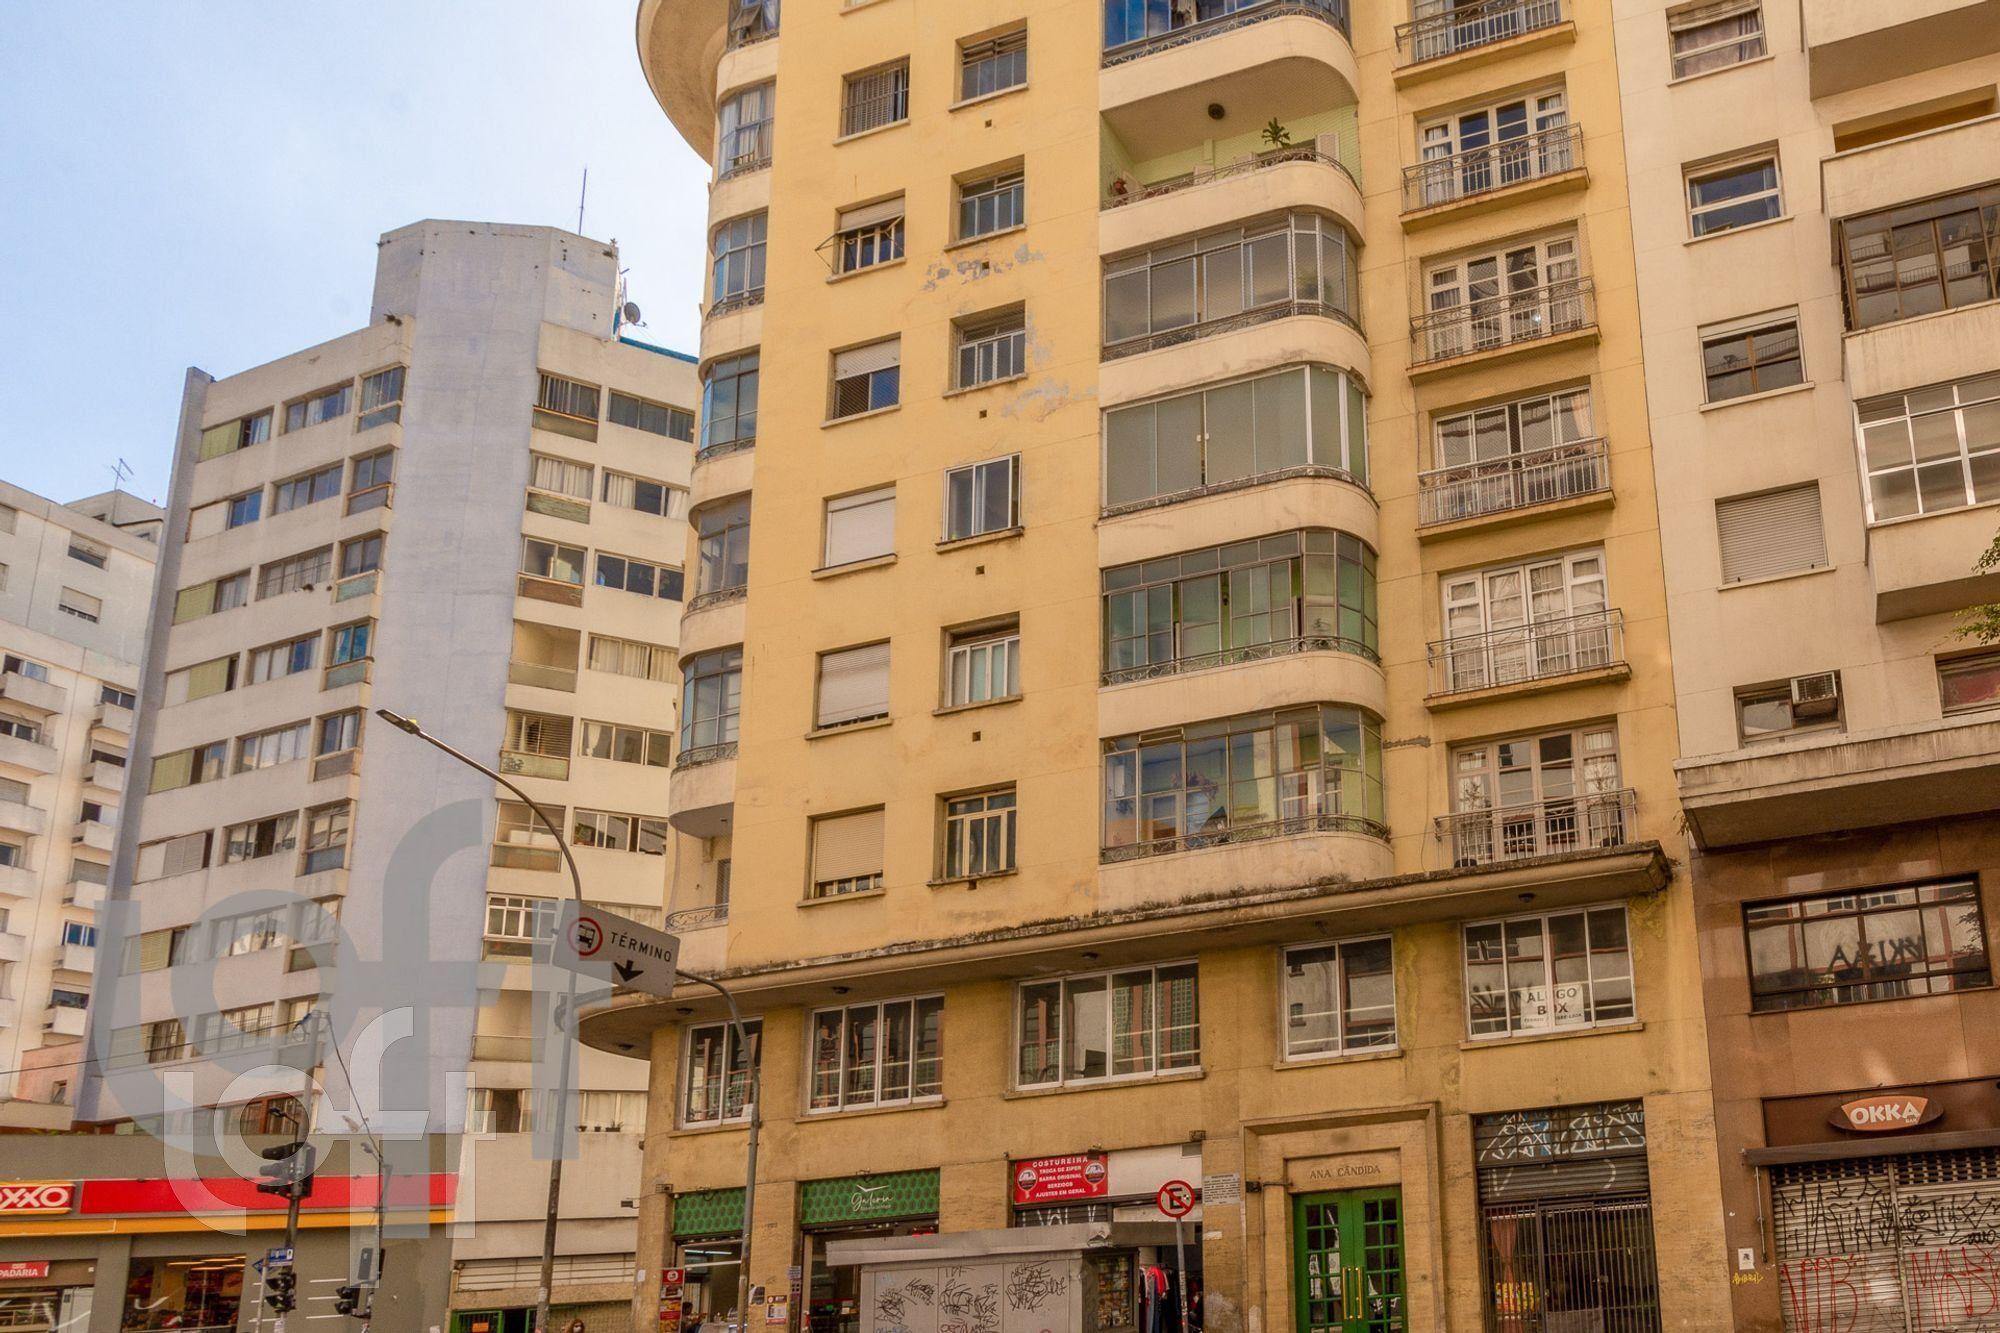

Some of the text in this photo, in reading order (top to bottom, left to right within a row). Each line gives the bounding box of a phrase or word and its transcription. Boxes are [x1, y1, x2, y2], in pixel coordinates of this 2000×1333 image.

[610, 931, 672, 962] TÉRMINO
[1527, 988, 1577, 1003] ALGO
[1537, 1002, 1569, 1016] BX
[1850, 1101, 1921, 1124] OKKA
[1032, 1157, 1087, 1167] COSTUREIRA
[1309, 1169, 1331, 1180] ANA
[0, 1187, 69, 1209] XXO
[1035, 1190, 1058, 1198] AJUSTES
